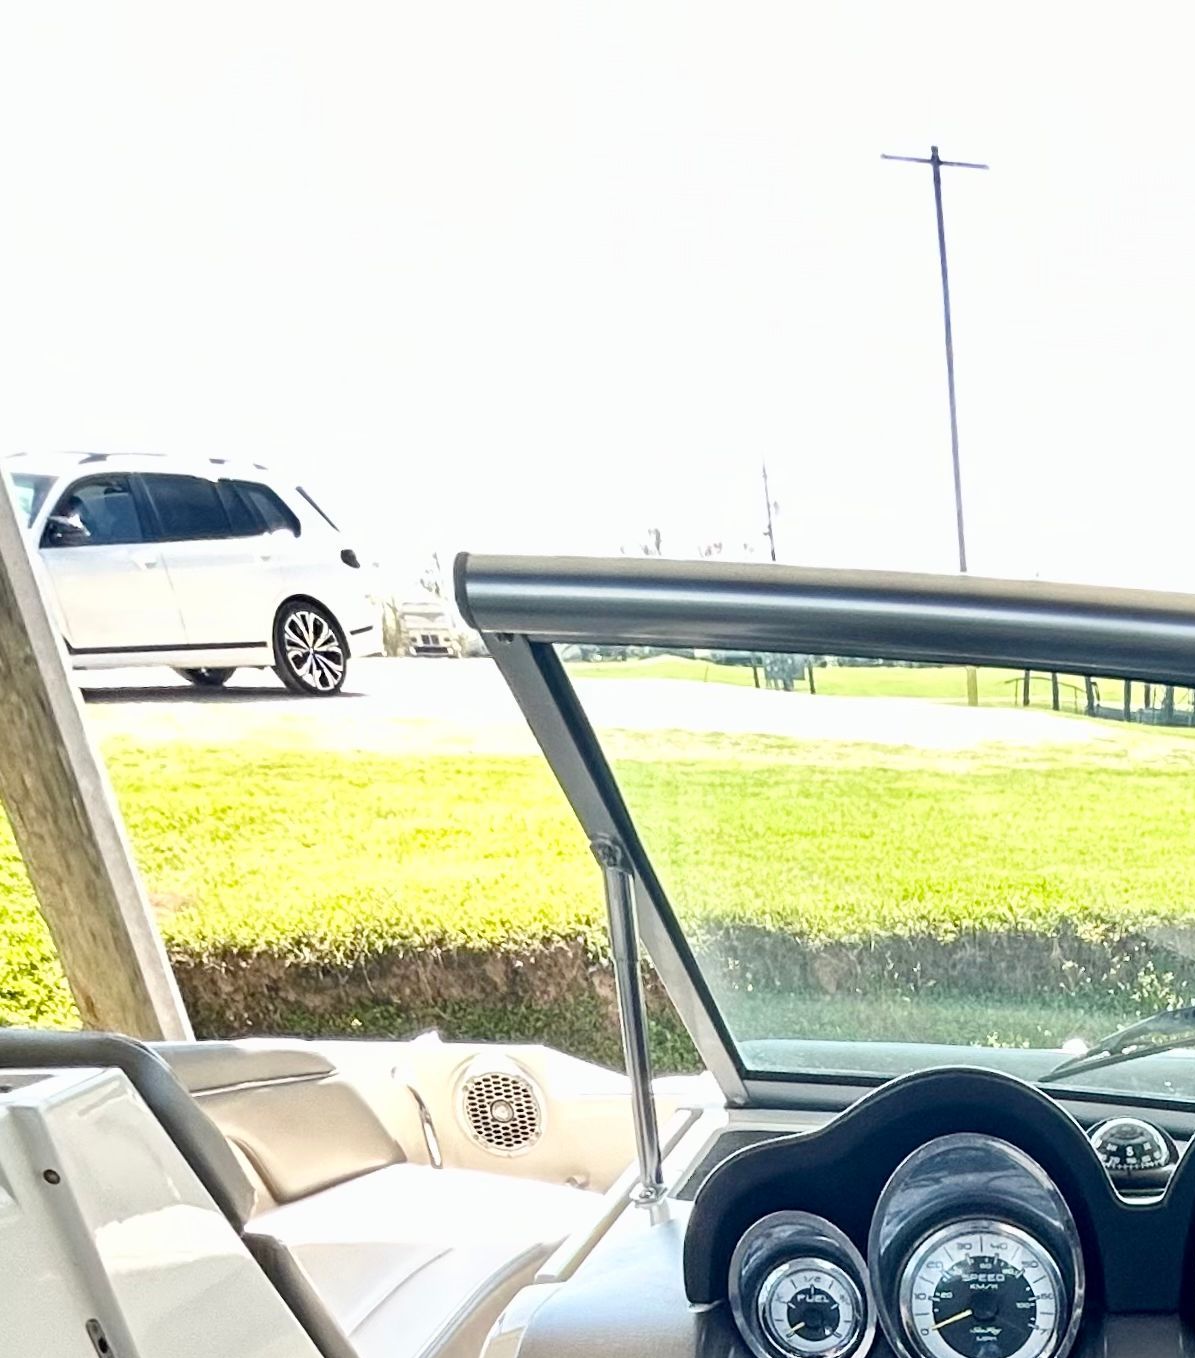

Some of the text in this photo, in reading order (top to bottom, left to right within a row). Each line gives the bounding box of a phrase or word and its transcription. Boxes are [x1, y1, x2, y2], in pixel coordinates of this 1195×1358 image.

[957, 1242, 973, 1250] 30
[990, 1242, 1008, 1250] 40
[961, 1273, 1006, 1282] SPEED
[796, 1293, 830, 1303] FUEL
[914, 1292, 927, 1301] 10
